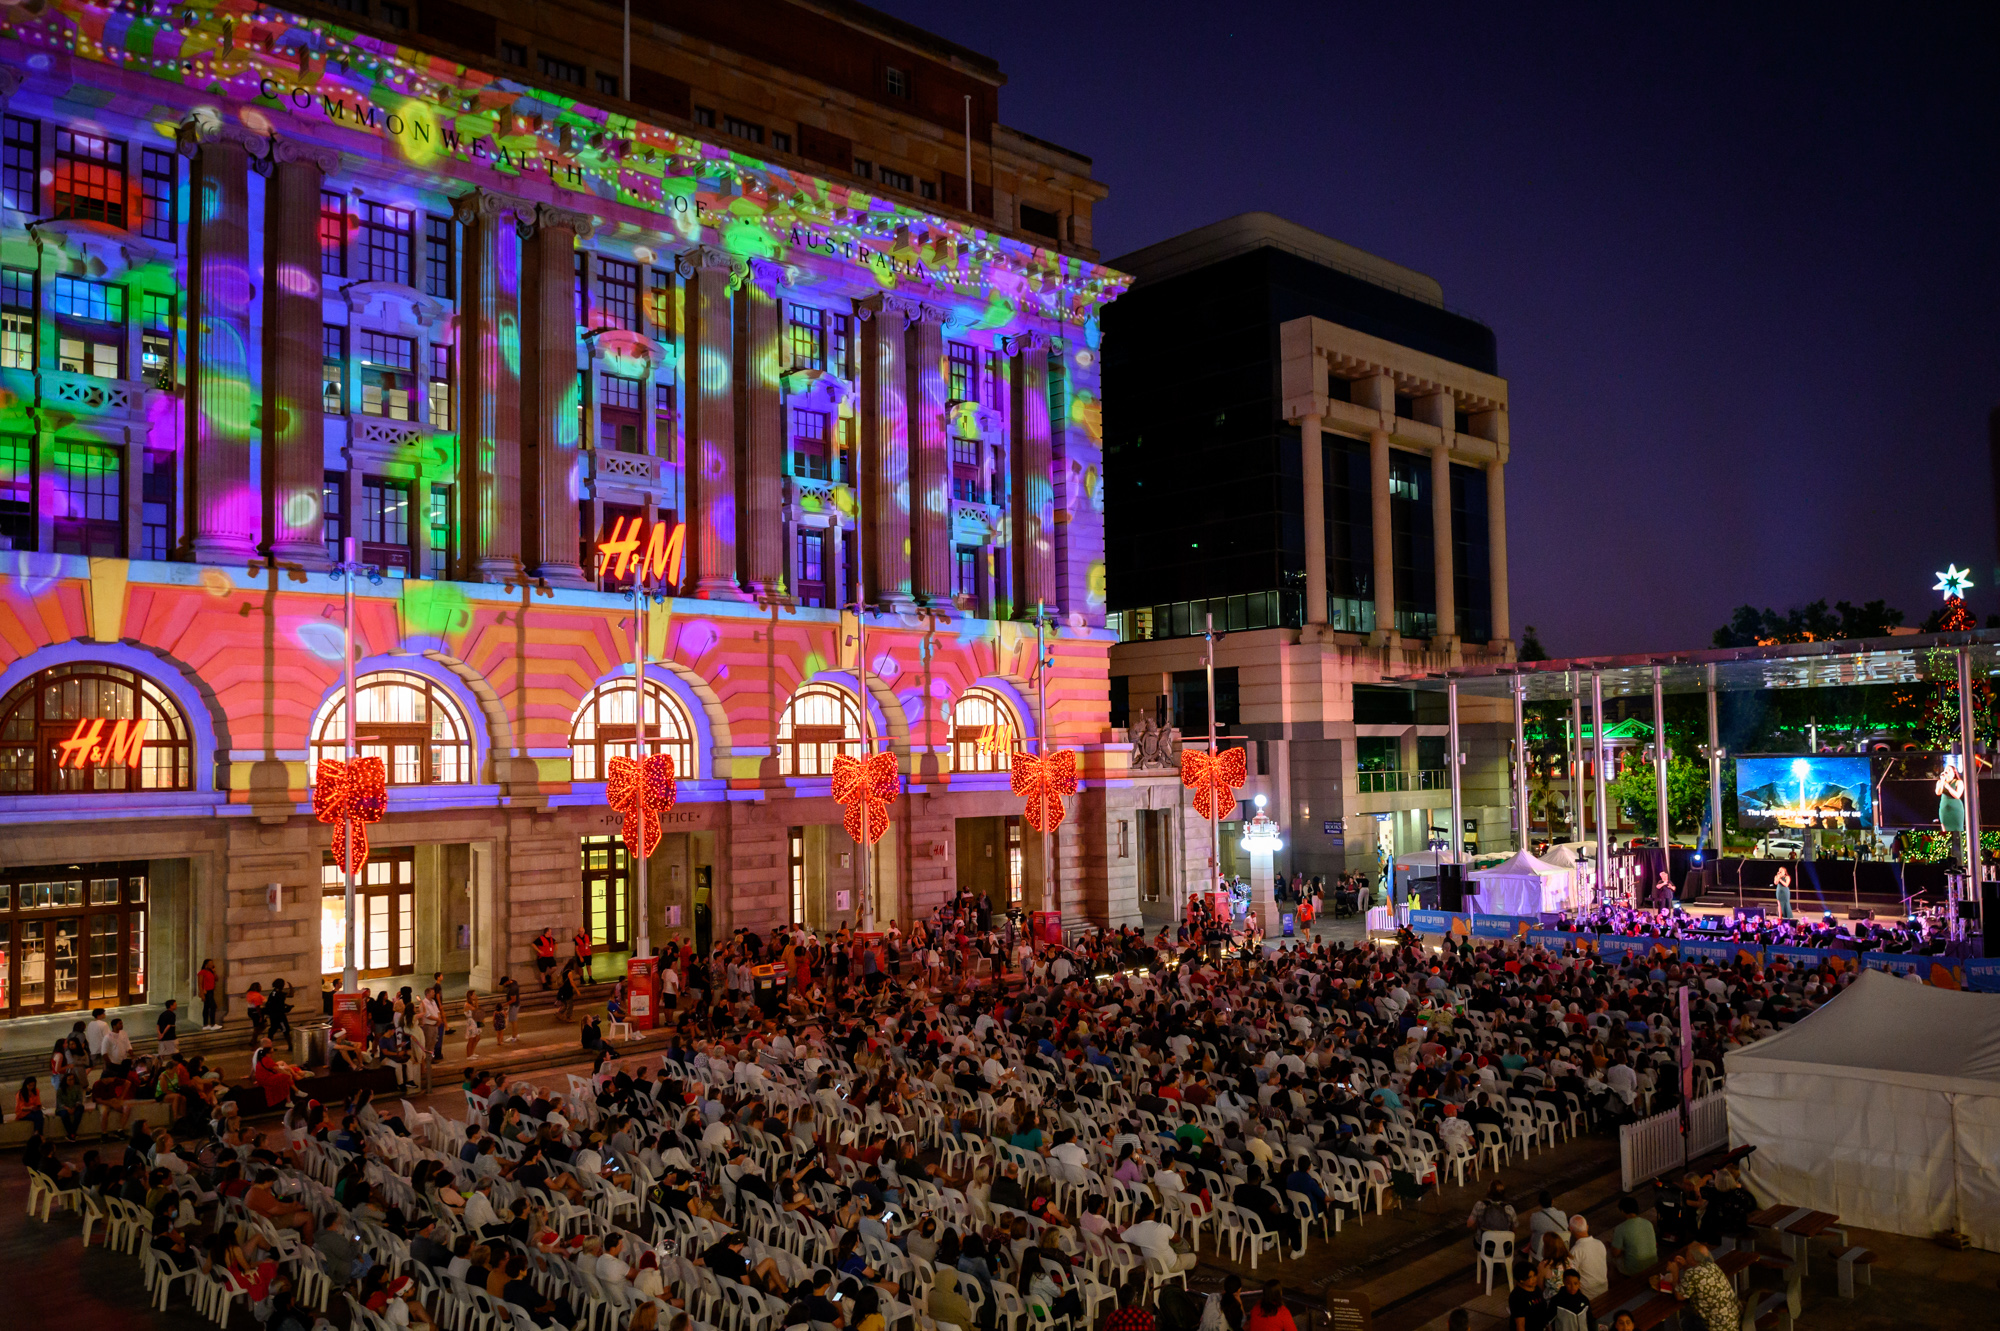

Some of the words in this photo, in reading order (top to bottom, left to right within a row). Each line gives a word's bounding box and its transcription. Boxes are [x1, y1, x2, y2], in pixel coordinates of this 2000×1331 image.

[260, 78, 584, 186] COMMONWEALTH
[674, 195, 708, 218] OF
[789, 227, 926, 280] AUSTRALIA
[598, 515, 687, 587] H&M
[58, 717, 150, 770] H&M
[974, 723, 1013, 757] H&M
[661, 811, 695, 823] FFICE
[1604, 940, 1614, 948] CITY
[1629, 942, 1643, 950] PERTH
[1684, 946, 1695, 955] CITY
[1710, 948, 1726, 957] PERTH
[1867, 958, 1880, 967] CITY
[1900, 961, 1917, 970] PERTH
[1972, 966, 1985, 976] CITY
[1986, 966, 1994, 976] OF
